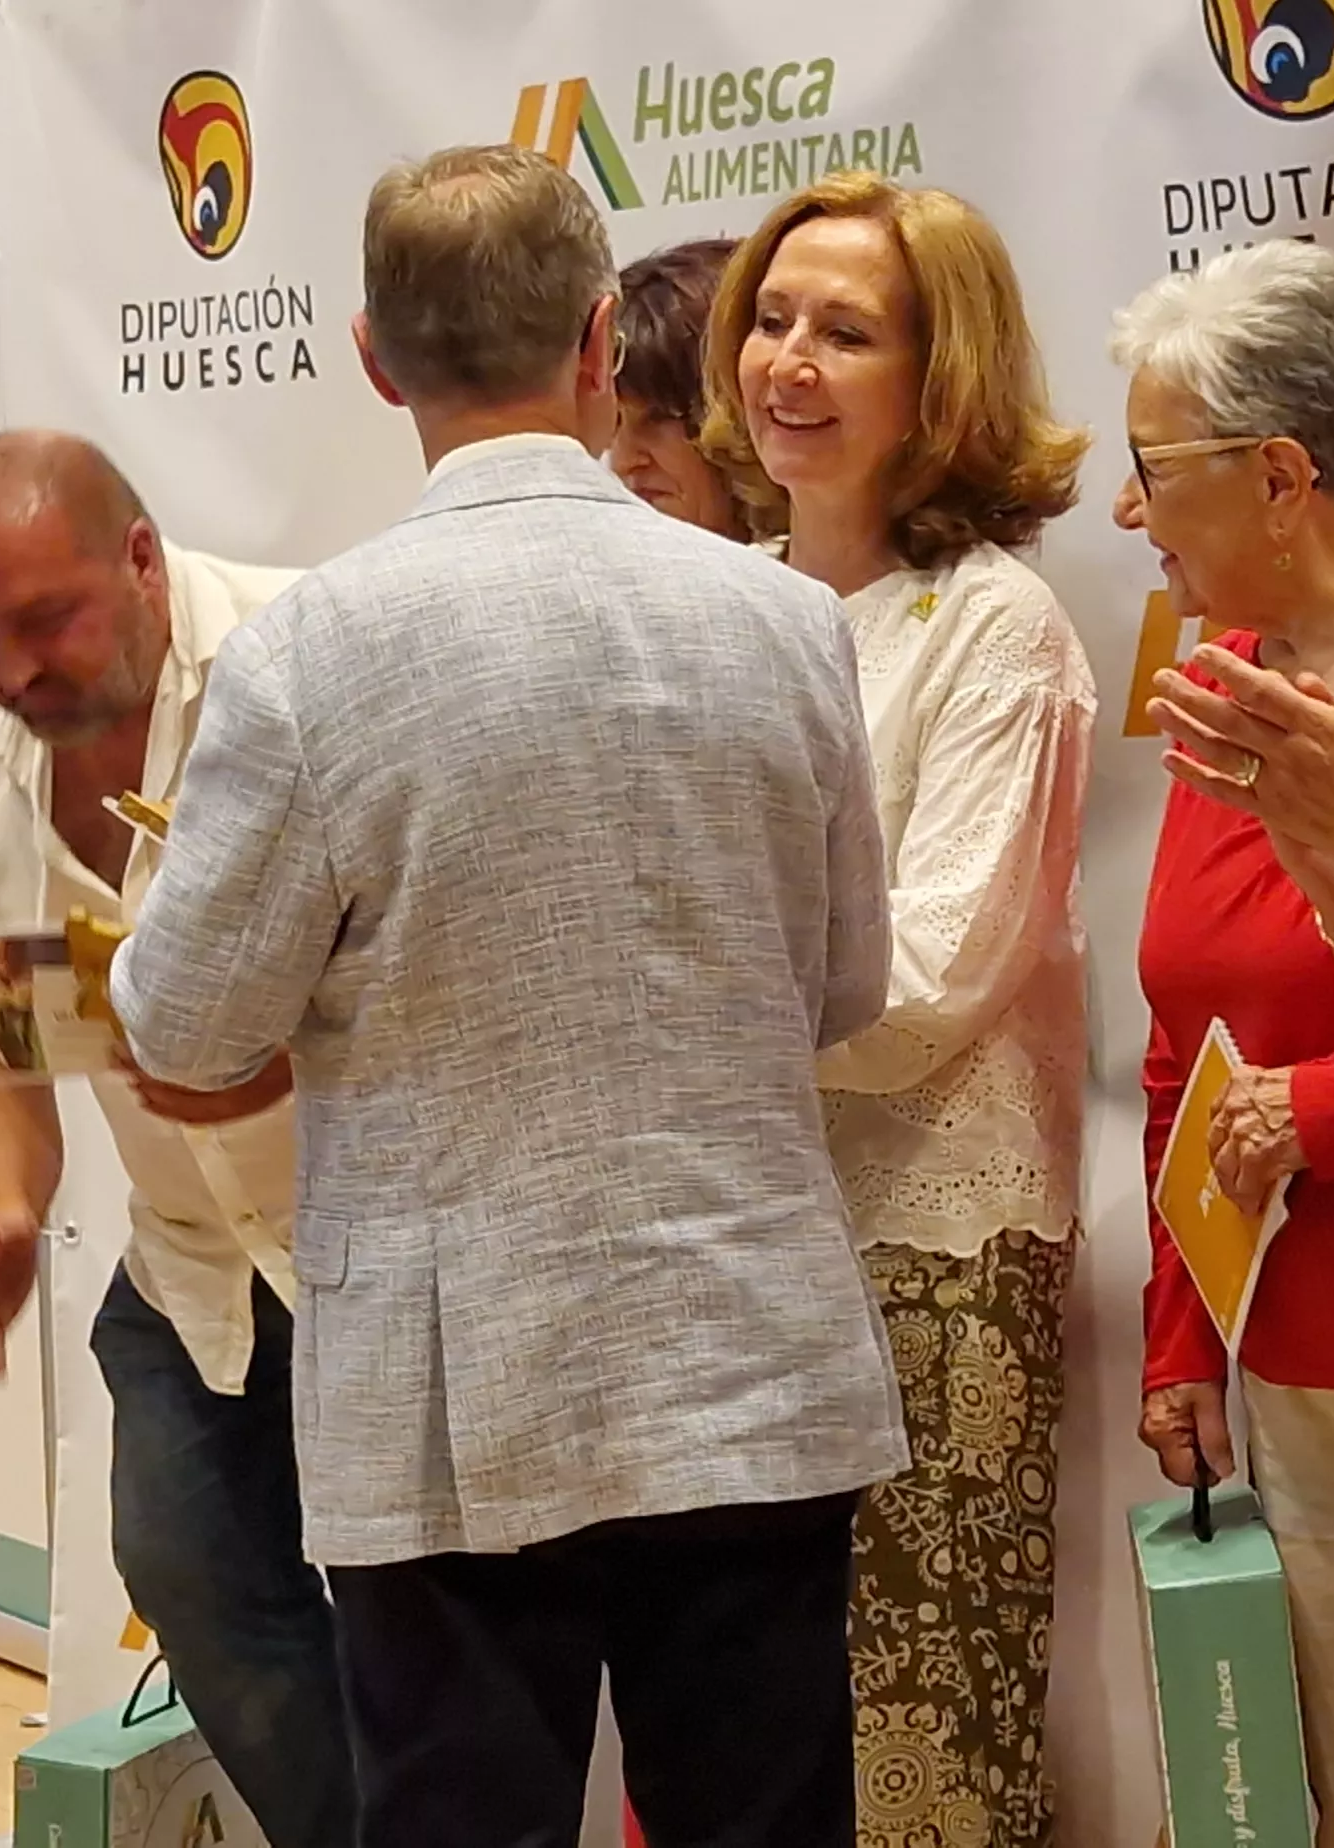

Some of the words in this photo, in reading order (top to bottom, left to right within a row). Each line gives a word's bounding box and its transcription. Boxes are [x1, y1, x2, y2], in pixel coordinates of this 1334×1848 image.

[633, 56, 835, 143] Huesca
[662, 122, 923, 206] ALIMENTARIA
[121, 273, 314, 344] DIPUTACIÓN
[122, 338, 317, 394] HUESCA
[1215, 1659, 1239, 1732] Huesca
